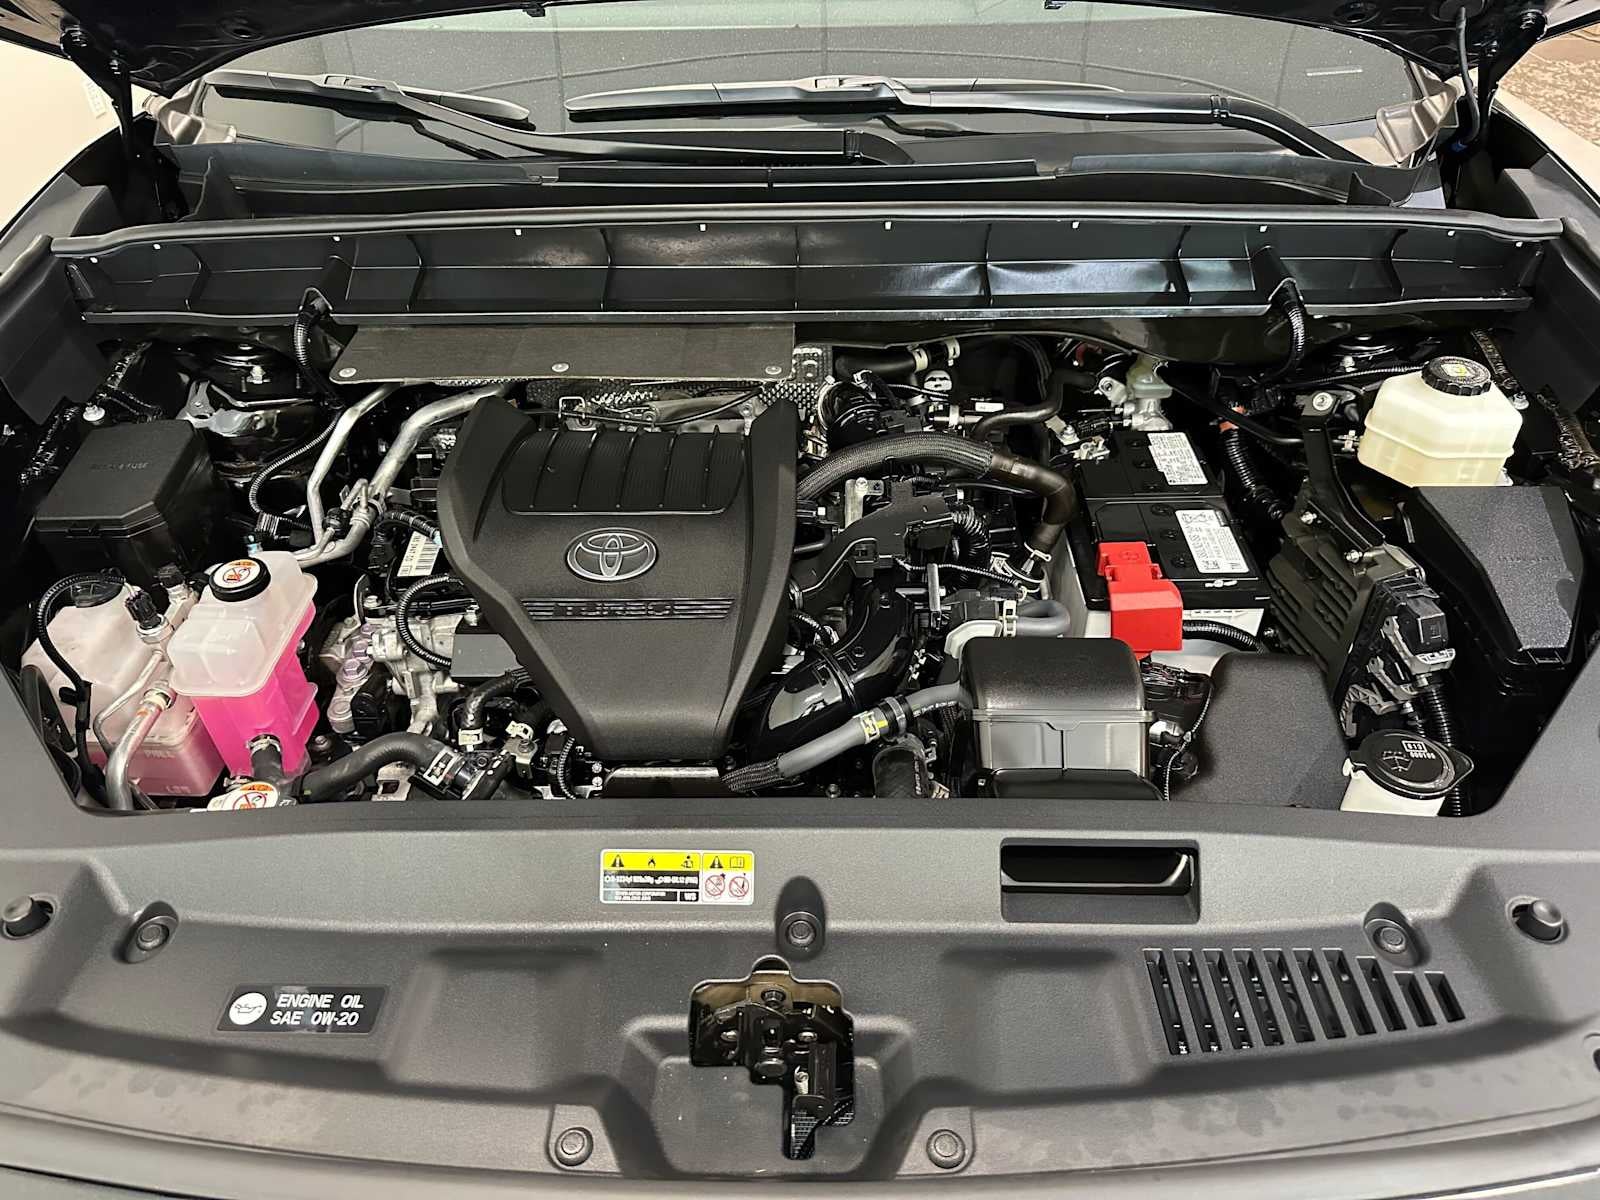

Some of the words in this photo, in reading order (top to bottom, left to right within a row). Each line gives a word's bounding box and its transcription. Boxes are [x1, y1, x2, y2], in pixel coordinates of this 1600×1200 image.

[554, 601, 673, 618] TURBO
[276, 993, 334, 1008] ENGINE
[340, 994, 364, 1009] OIL
[270, 1010, 304, 1025] SAE
[311, 1011, 359, 1026] 0W-20
